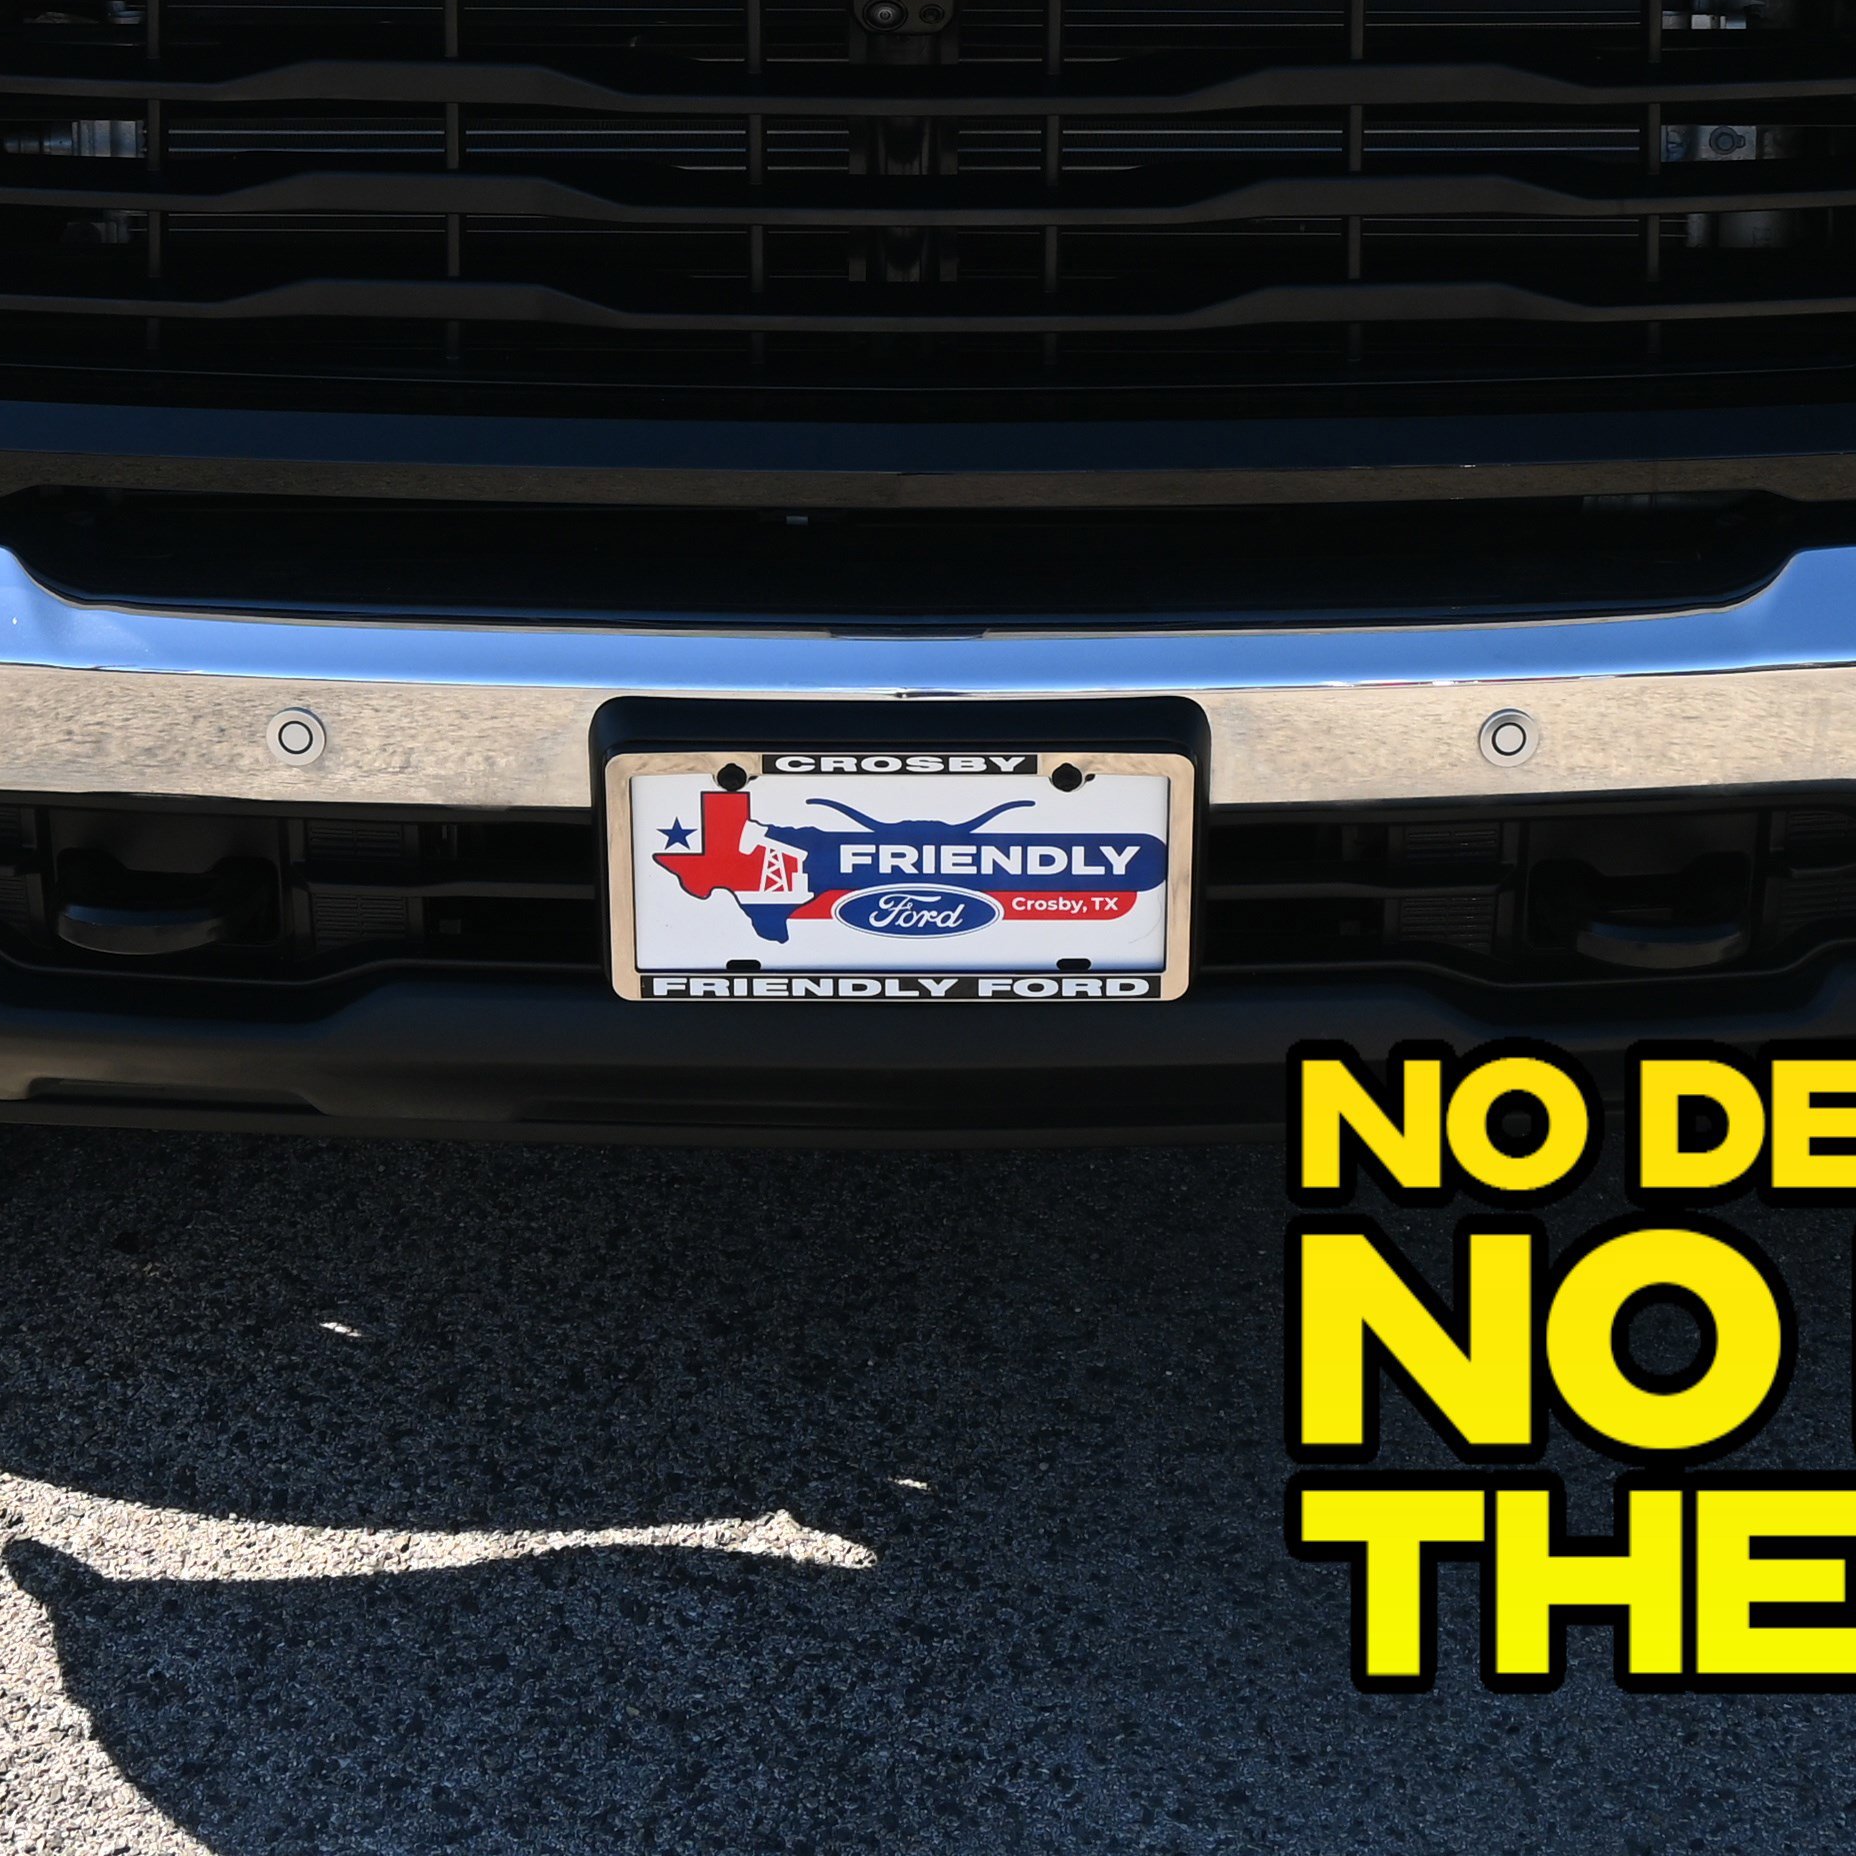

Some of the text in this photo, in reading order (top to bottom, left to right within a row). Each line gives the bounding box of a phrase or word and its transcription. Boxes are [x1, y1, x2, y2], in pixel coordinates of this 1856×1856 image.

[774, 755, 1027, 774] CROSBY
[839, 844, 1141, 876] FRIENDLY
[868, 894, 966, 928] Ford
[1011, 896, 1119, 916] Crosby, TX
[652, 977, 1151, 997] FRIENDLY FORD
